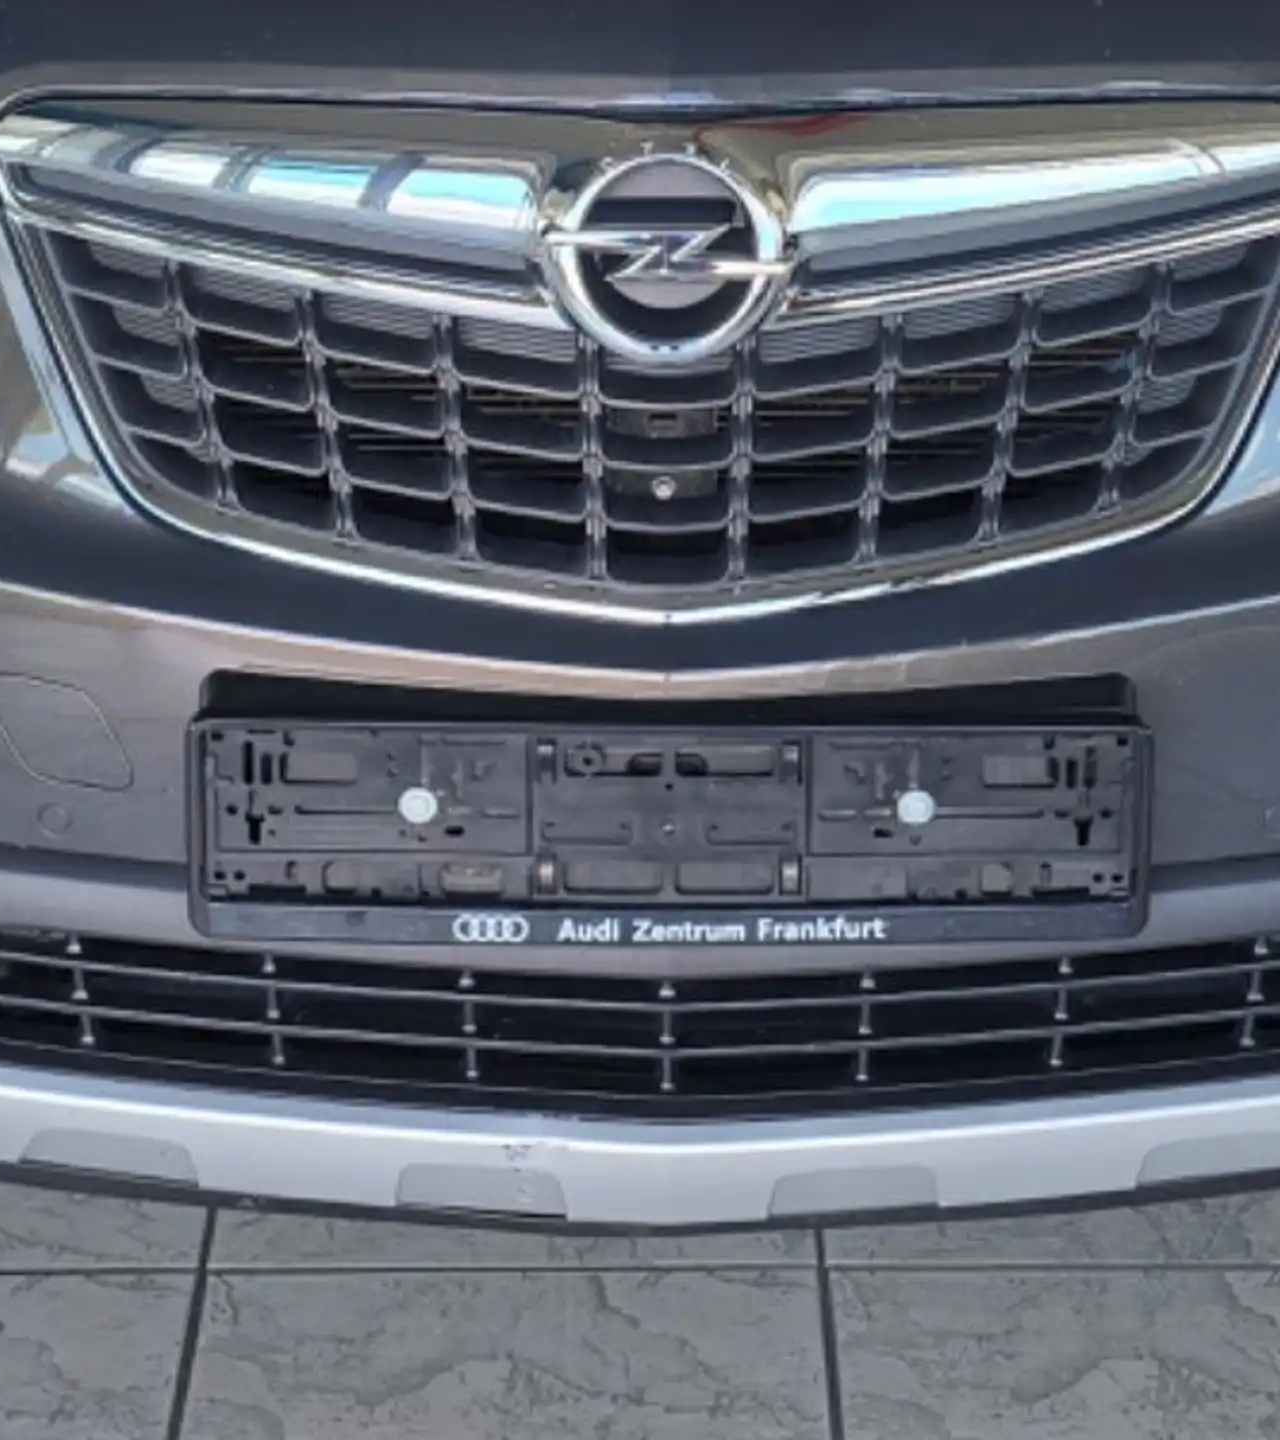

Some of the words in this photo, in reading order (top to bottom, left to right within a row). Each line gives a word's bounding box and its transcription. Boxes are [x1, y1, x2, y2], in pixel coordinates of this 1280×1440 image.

[556, 917, 620, 943] Audi
[631, 917, 746, 943] Zentrum
[757, 915, 888, 942] Frankfurt
